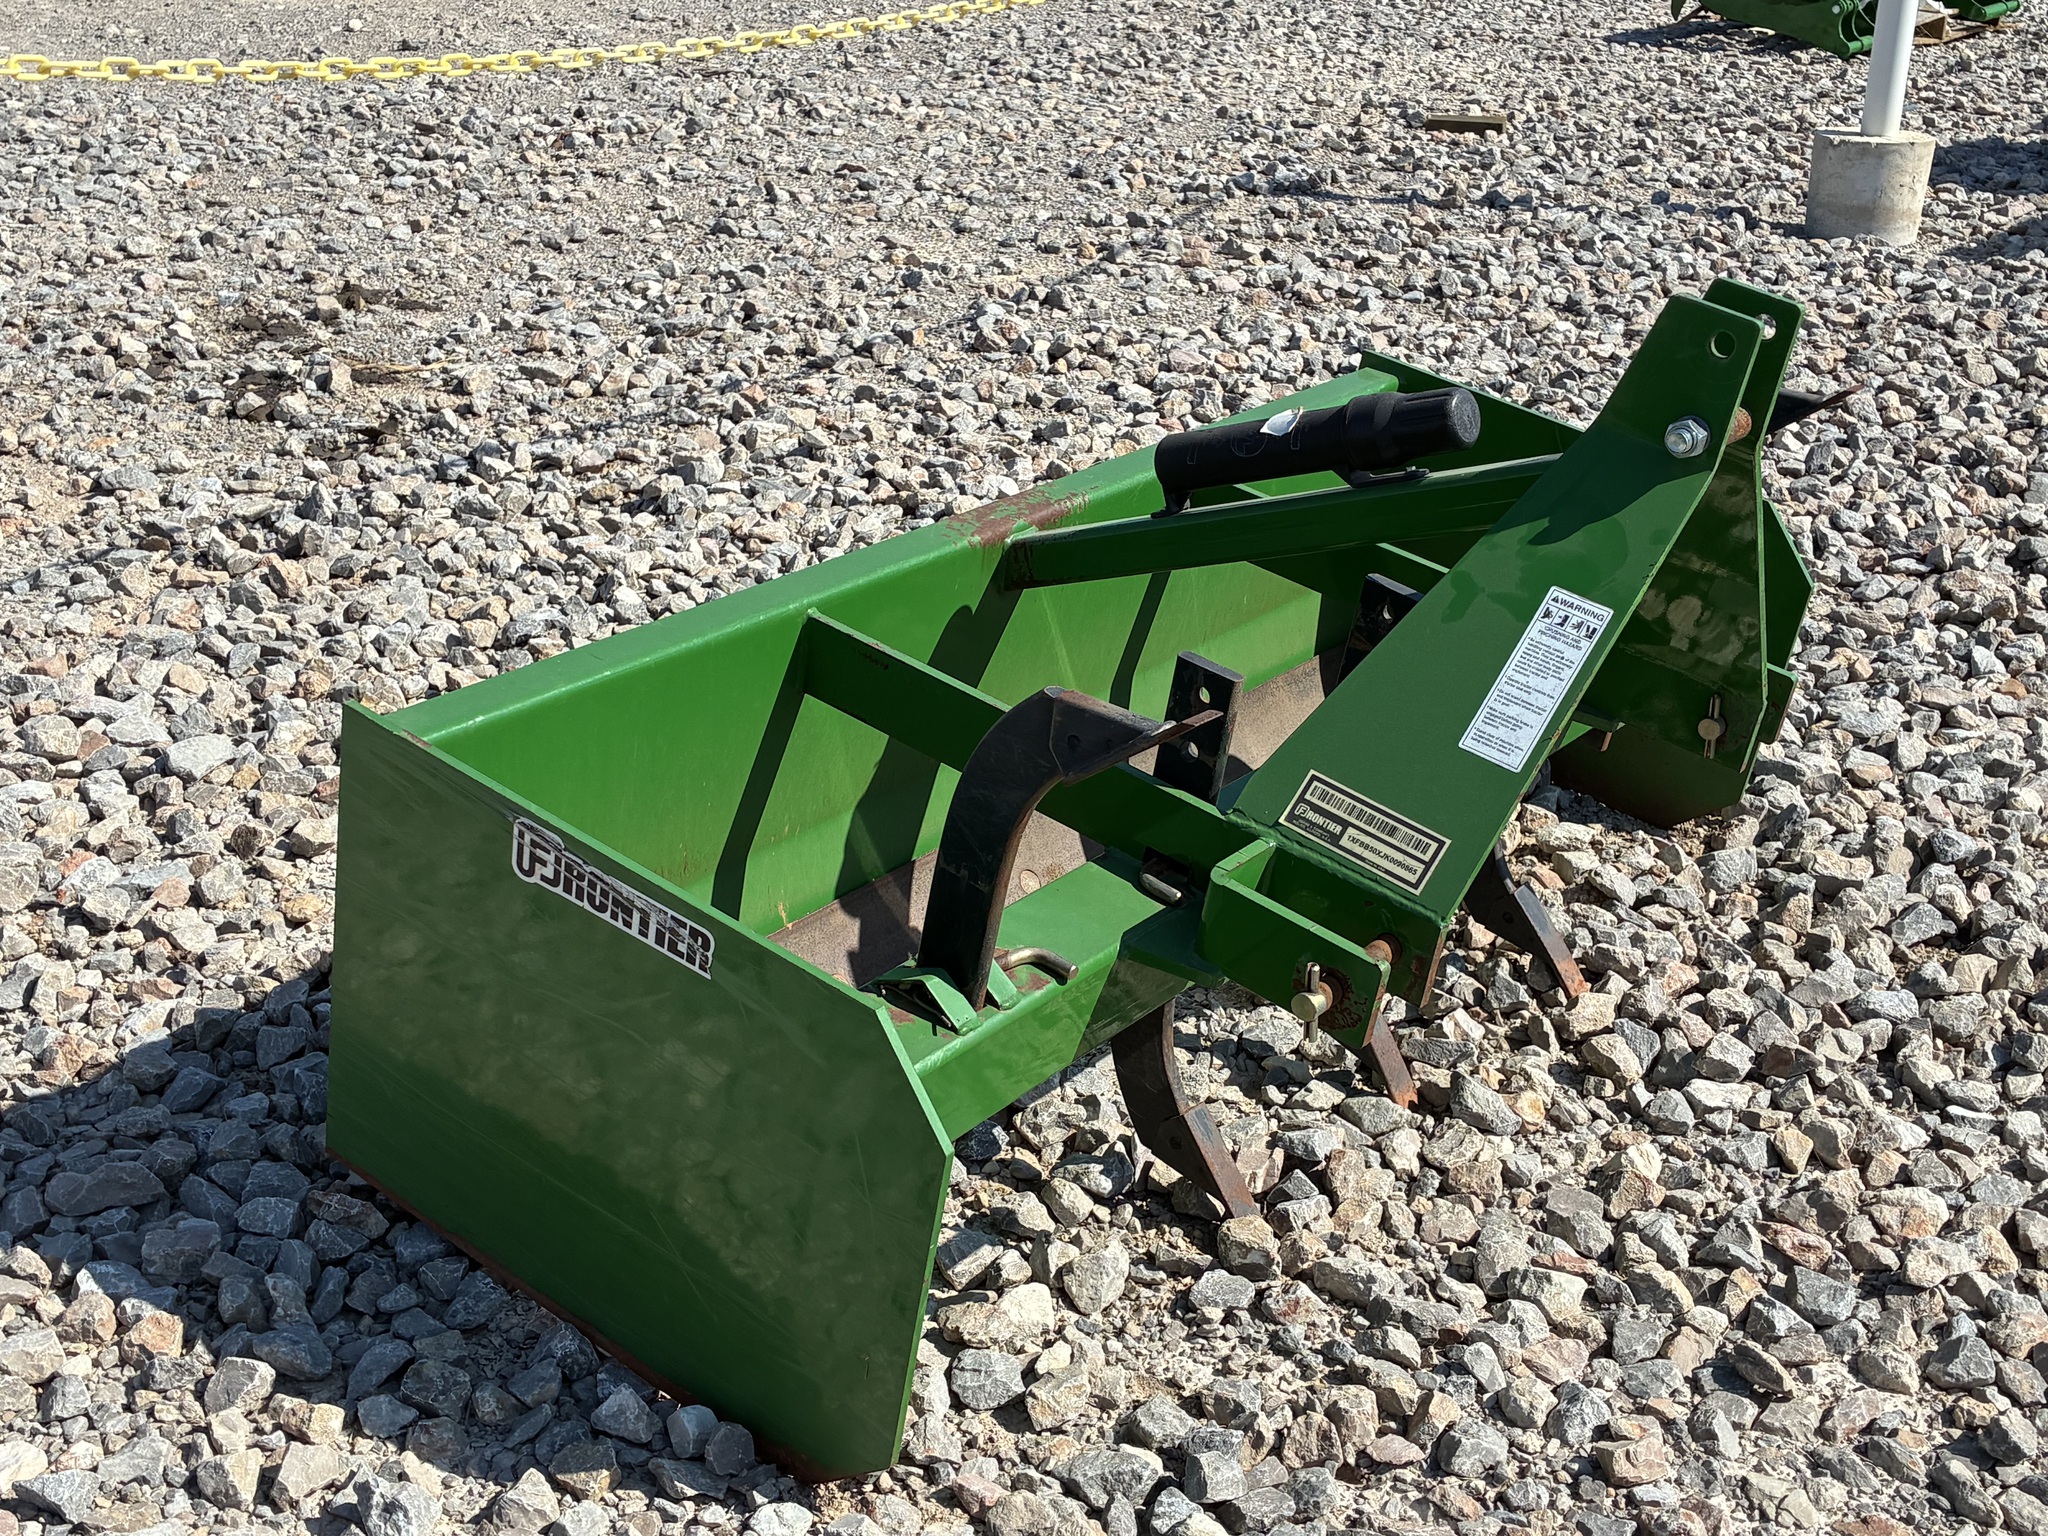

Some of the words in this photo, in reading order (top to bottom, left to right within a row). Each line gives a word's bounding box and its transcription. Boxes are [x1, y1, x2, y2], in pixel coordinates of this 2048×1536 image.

[1560, 598, 1605, 621] WARNING
[1537, 630, 1562, 643] PINCHING
[1561, 639, 1583, 651] HAZARD
[1544, 626, 1571, 640] CRUSHING
[1295, 804, 1342, 834] FRONTIER
